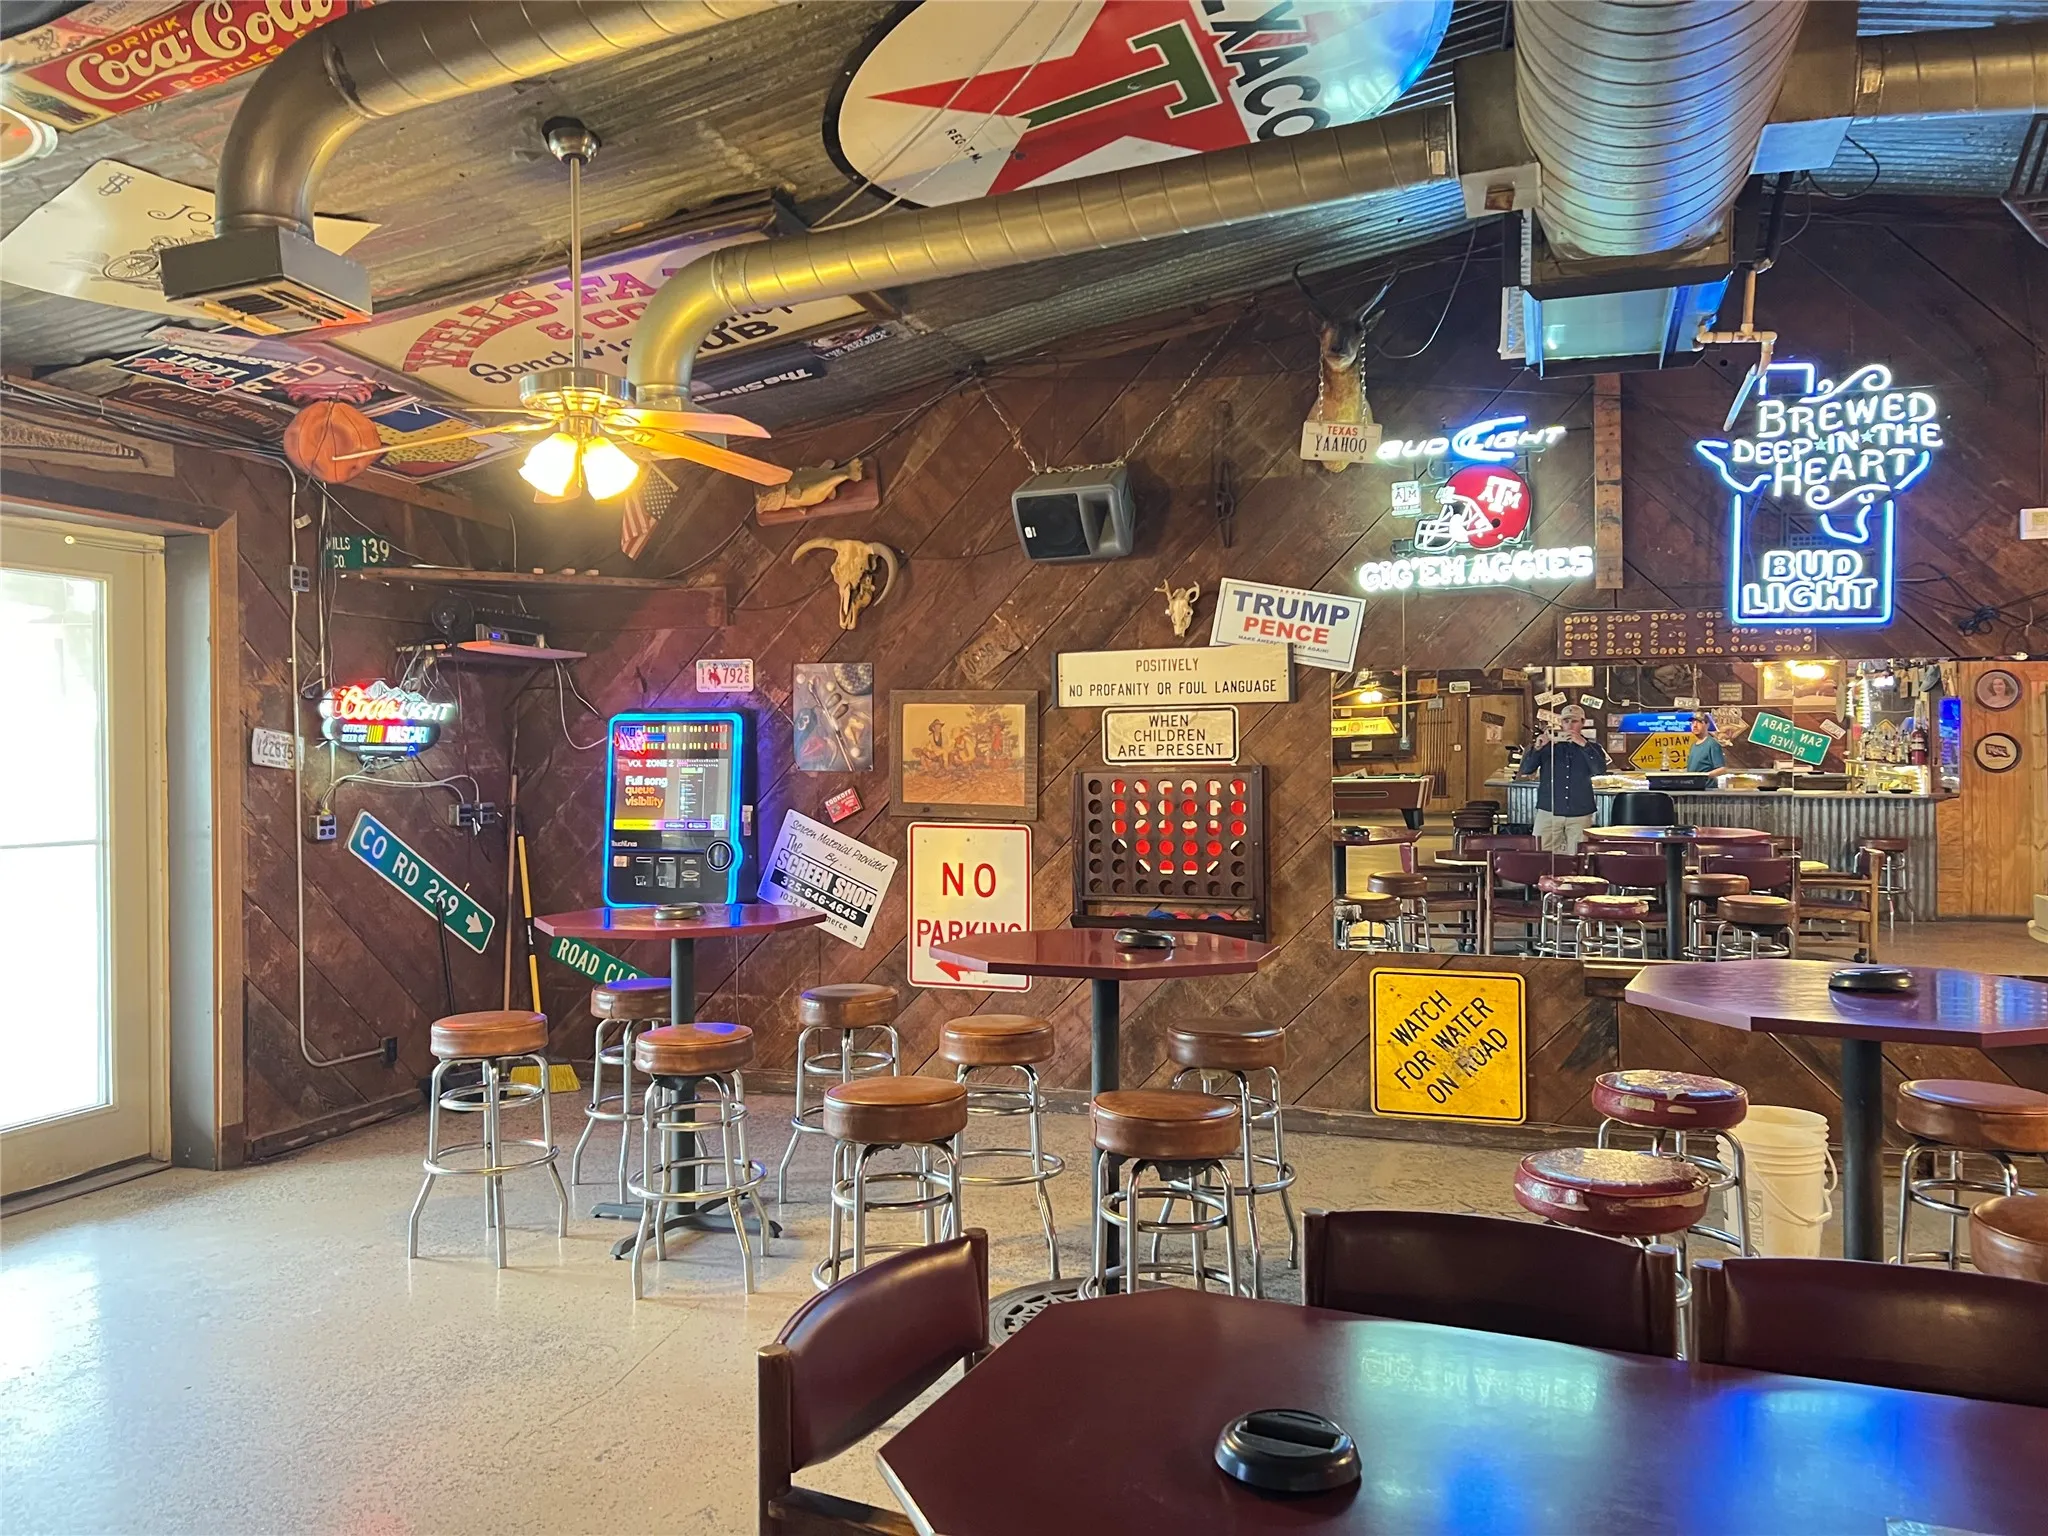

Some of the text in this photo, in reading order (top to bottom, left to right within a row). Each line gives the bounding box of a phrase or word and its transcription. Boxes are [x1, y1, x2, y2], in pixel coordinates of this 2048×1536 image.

[66, 0, 333, 101] Coca-Cola
[106, 16, 181, 56] DRINK
[135, 44, 284, 102] IN BOTTLES
[1203, 0, 1332, 141] XACO
[124, 357, 236, 390] Coors
[166, 353, 250, 379] LIGHT
[1327, 424, 1359, 437] TEXAS
[1756, 391, 1938, 441] BREWED
[1314, 434, 1368, 454] YAAHOO
[1374, 424, 1573, 462] BUD LIGHT
[1732, 421, 1944, 466] DEEP IN THE
[1772, 447, 1917, 498] HEART
[361, 537, 390, 564] 139
[1468, 545, 1595, 587] AGGIES
[1762, 549, 1864, 583] BUD
[1232, 589, 1351, 627] TRUMP
[1741, 577, 1879, 615] LIGHT
[1238, 634, 1256, 642] MAKE
[1243, 616, 1330, 645] PENCE
[723, 667, 743, 684] 792
[1135, 657, 1200, 673] POSITIVELY
[1069, 679, 1277, 698] NO PROFANITY OR FOUL LANGUAGE
[1133, 728, 1206, 742] CHILDREN
[1149, 714, 1189, 728] WHEN
[1117, 742, 1224, 757] ARE PRESENT
[625, 775, 668, 789] Full song
[625, 787, 655, 797] queue
[625, 797, 663, 809] visibility
[360, 825, 388, 860] CO
[392, 851, 420, 887] RD
[786, 833, 804, 855] The
[790, 820, 889, 873] Screen Material Provided
[776, 849, 877, 911] SCREEN SHOP
[781, 875, 859, 921] 325-646-4645
[942, 862, 997, 898] NO
[557, 938, 600, 976] ROAD
[1390, 989, 1453, 1047] WATCH
[1394, 997, 1494, 1090] FOR WATER
[1426, 1028, 1509, 1104] ON ROAD
